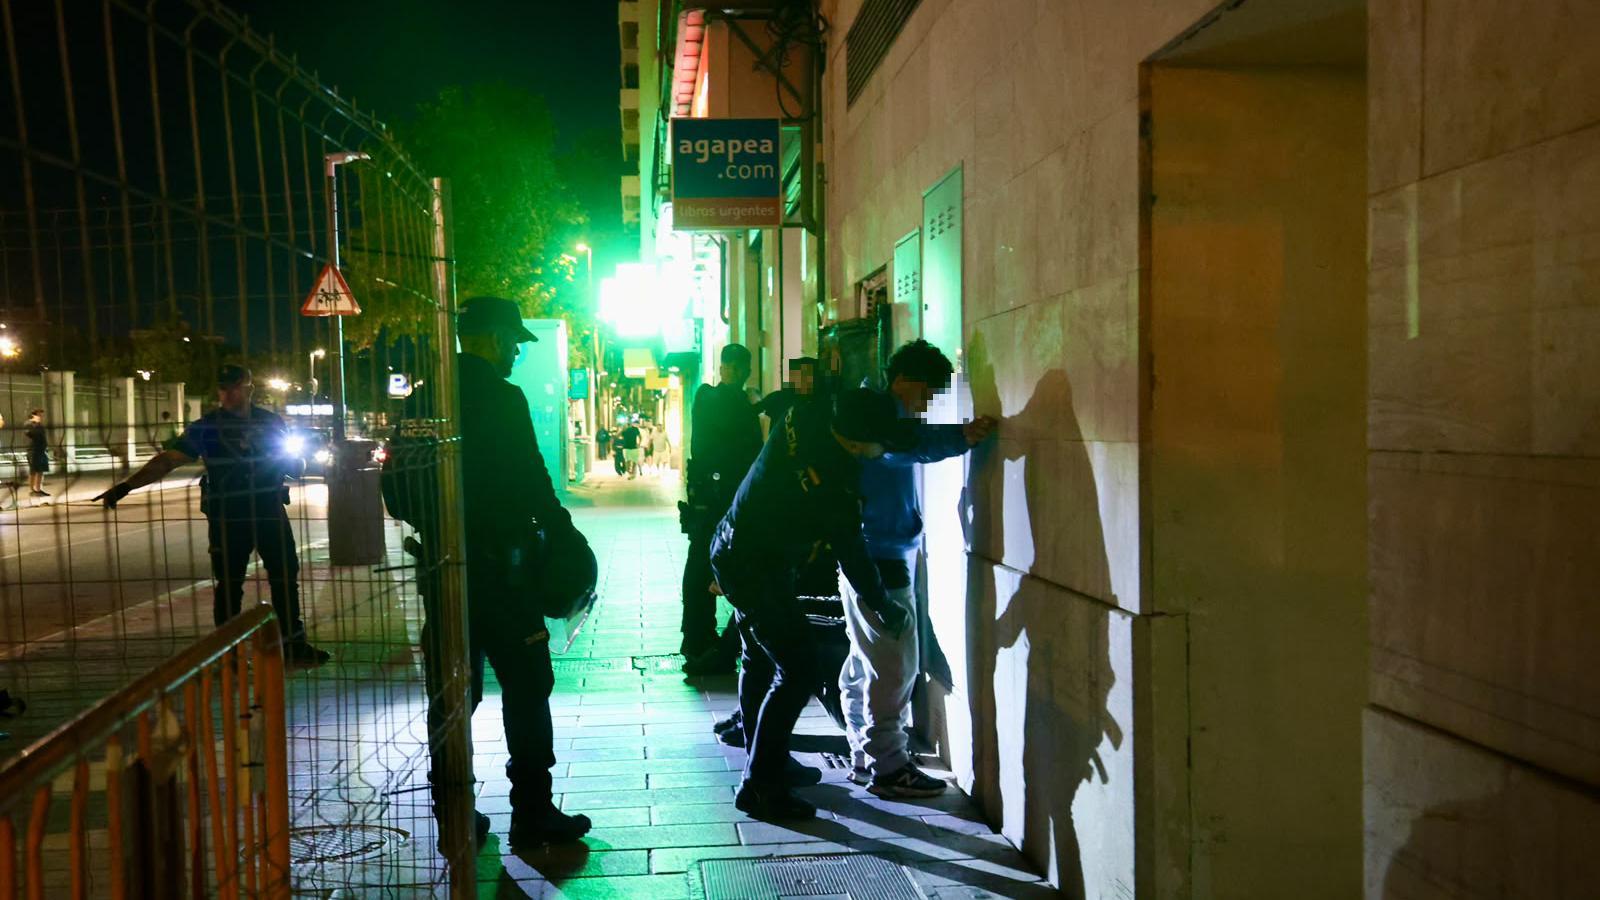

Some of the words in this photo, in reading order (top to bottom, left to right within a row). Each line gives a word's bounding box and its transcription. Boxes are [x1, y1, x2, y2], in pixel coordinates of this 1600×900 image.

[679, 139, 774, 163] agapea
[717, 164, 774, 179] .com
[681, 206, 715, 217] libros
[720, 206, 775, 220] urgentes
